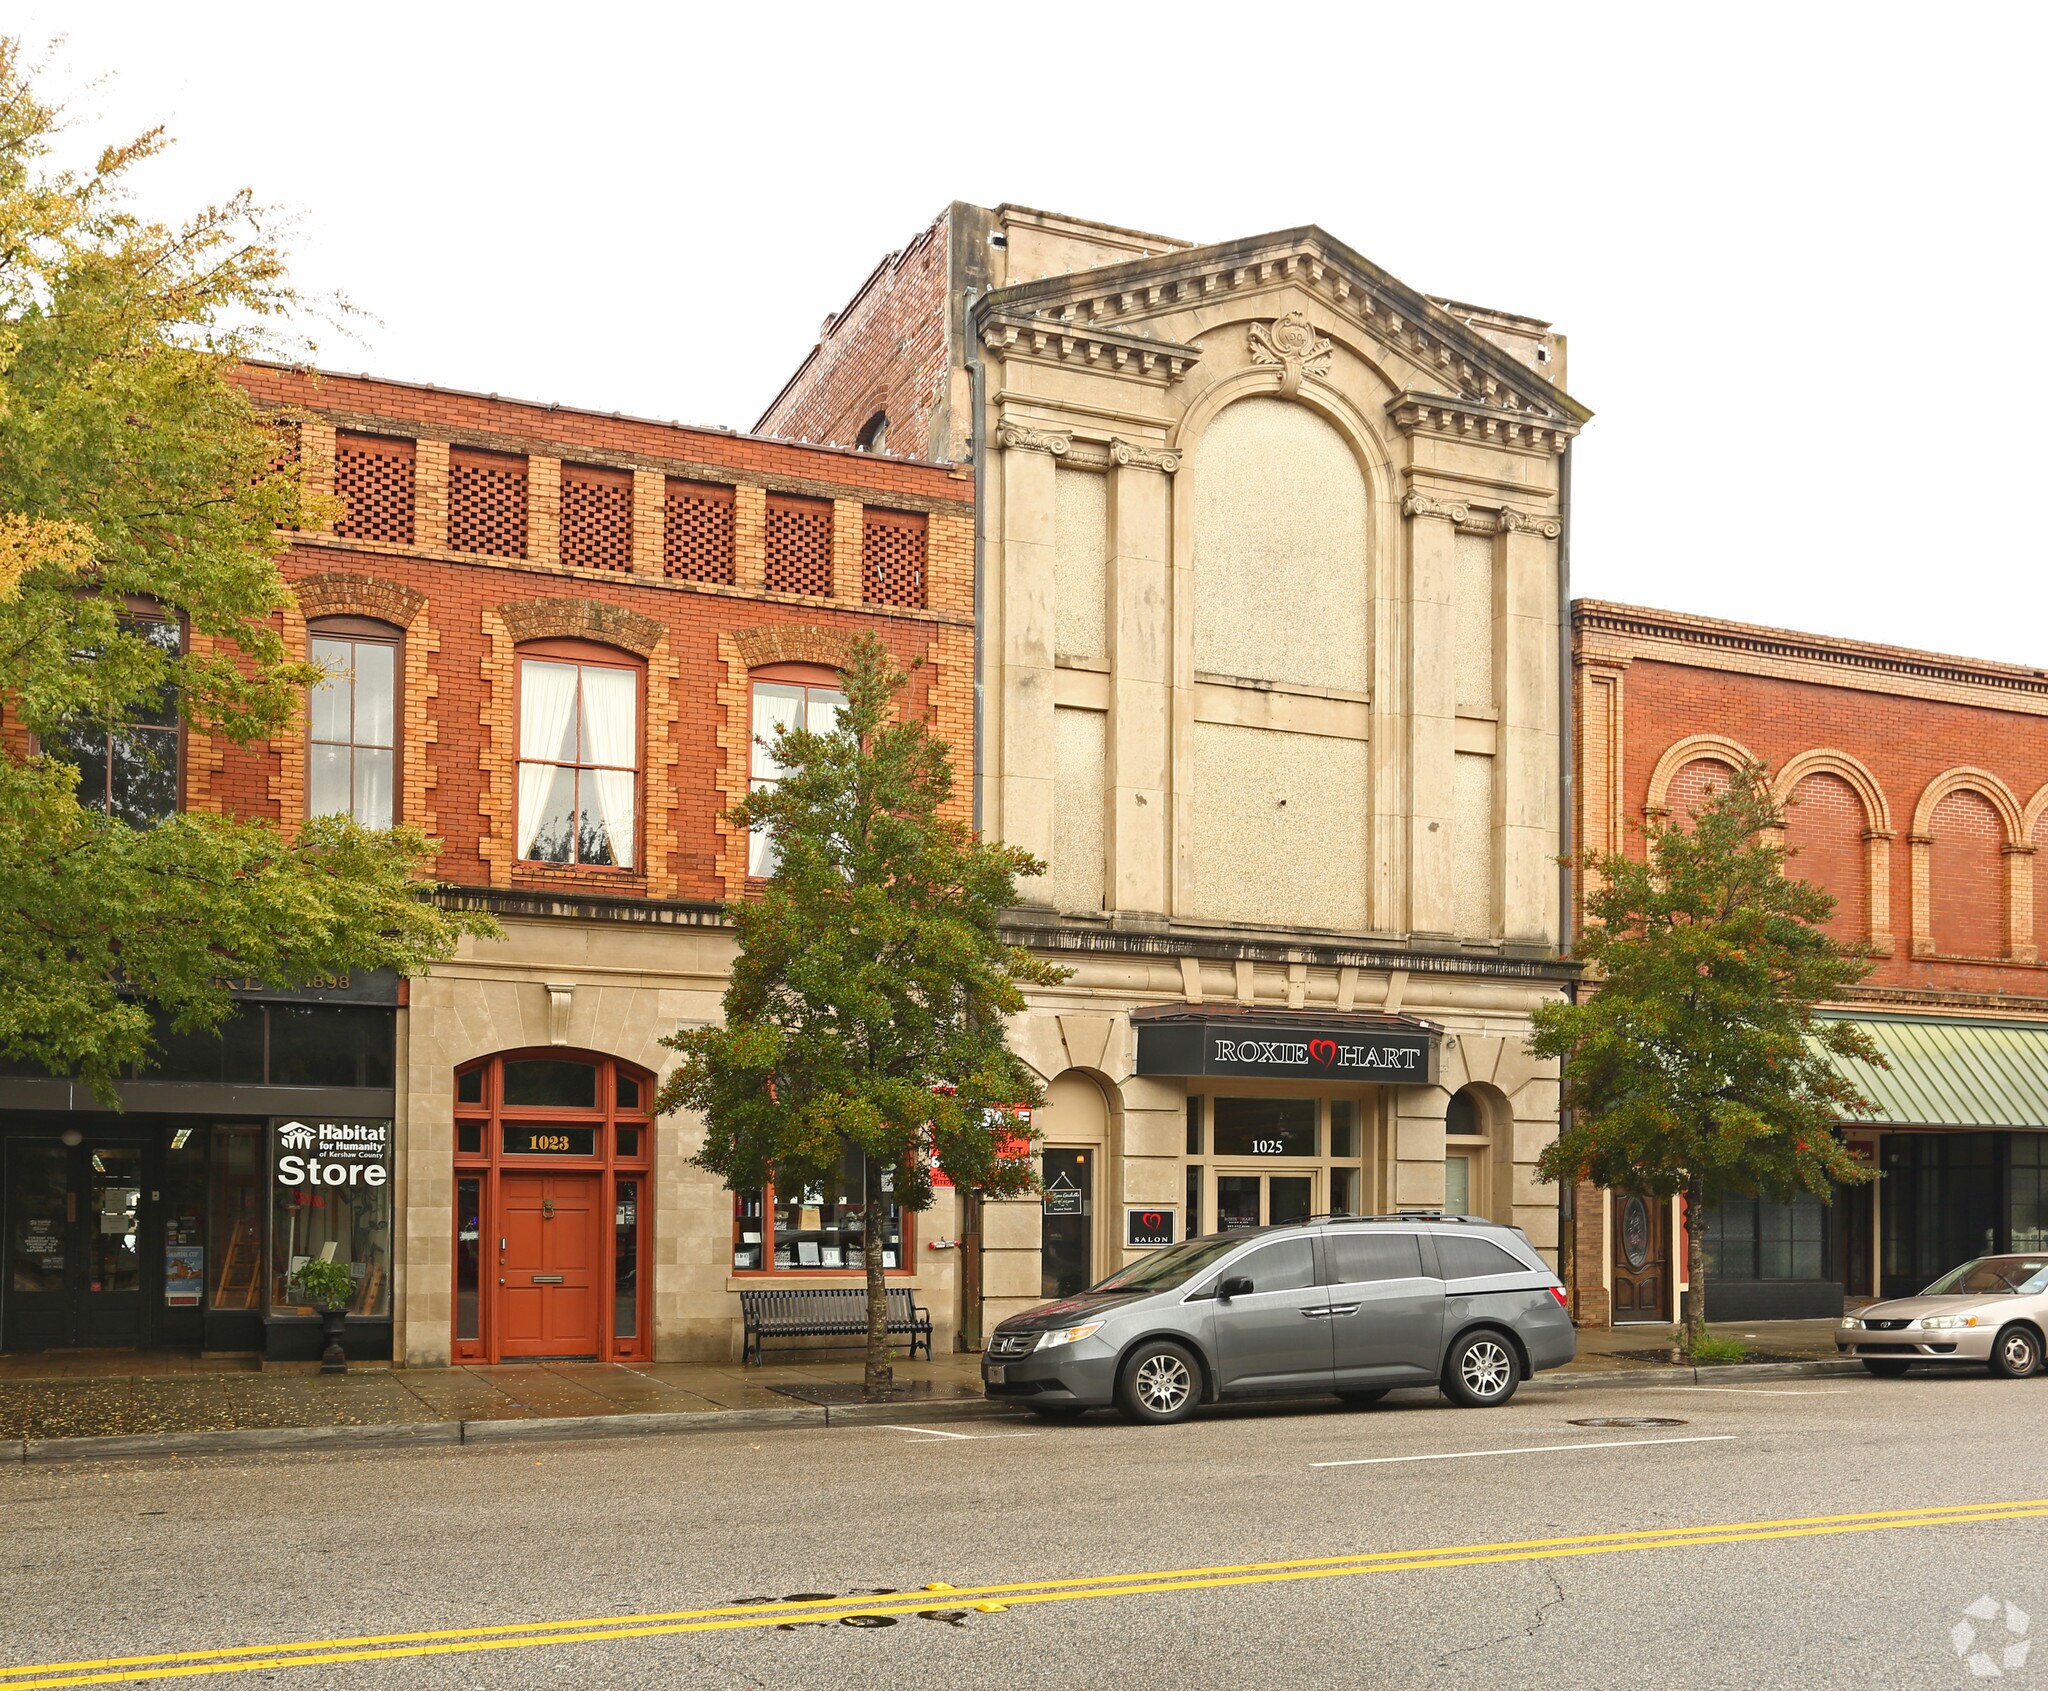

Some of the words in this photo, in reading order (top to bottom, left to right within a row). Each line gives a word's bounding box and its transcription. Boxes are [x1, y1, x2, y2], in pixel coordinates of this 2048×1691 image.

[305, 974, 350, 989] 1898
[1214, 1039, 1309, 1065] ROXIE
[1337, 1045, 1421, 1069] HART
[318, 1124, 386, 1141] Habitat
[319, 1141, 334, 1150] for
[336, 1141, 384, 1153] Humanity
[528, 1134, 570, 1151] 1023
[1252, 1139, 1283, 1154] 1025
[277, 1155, 387, 1186] Store
